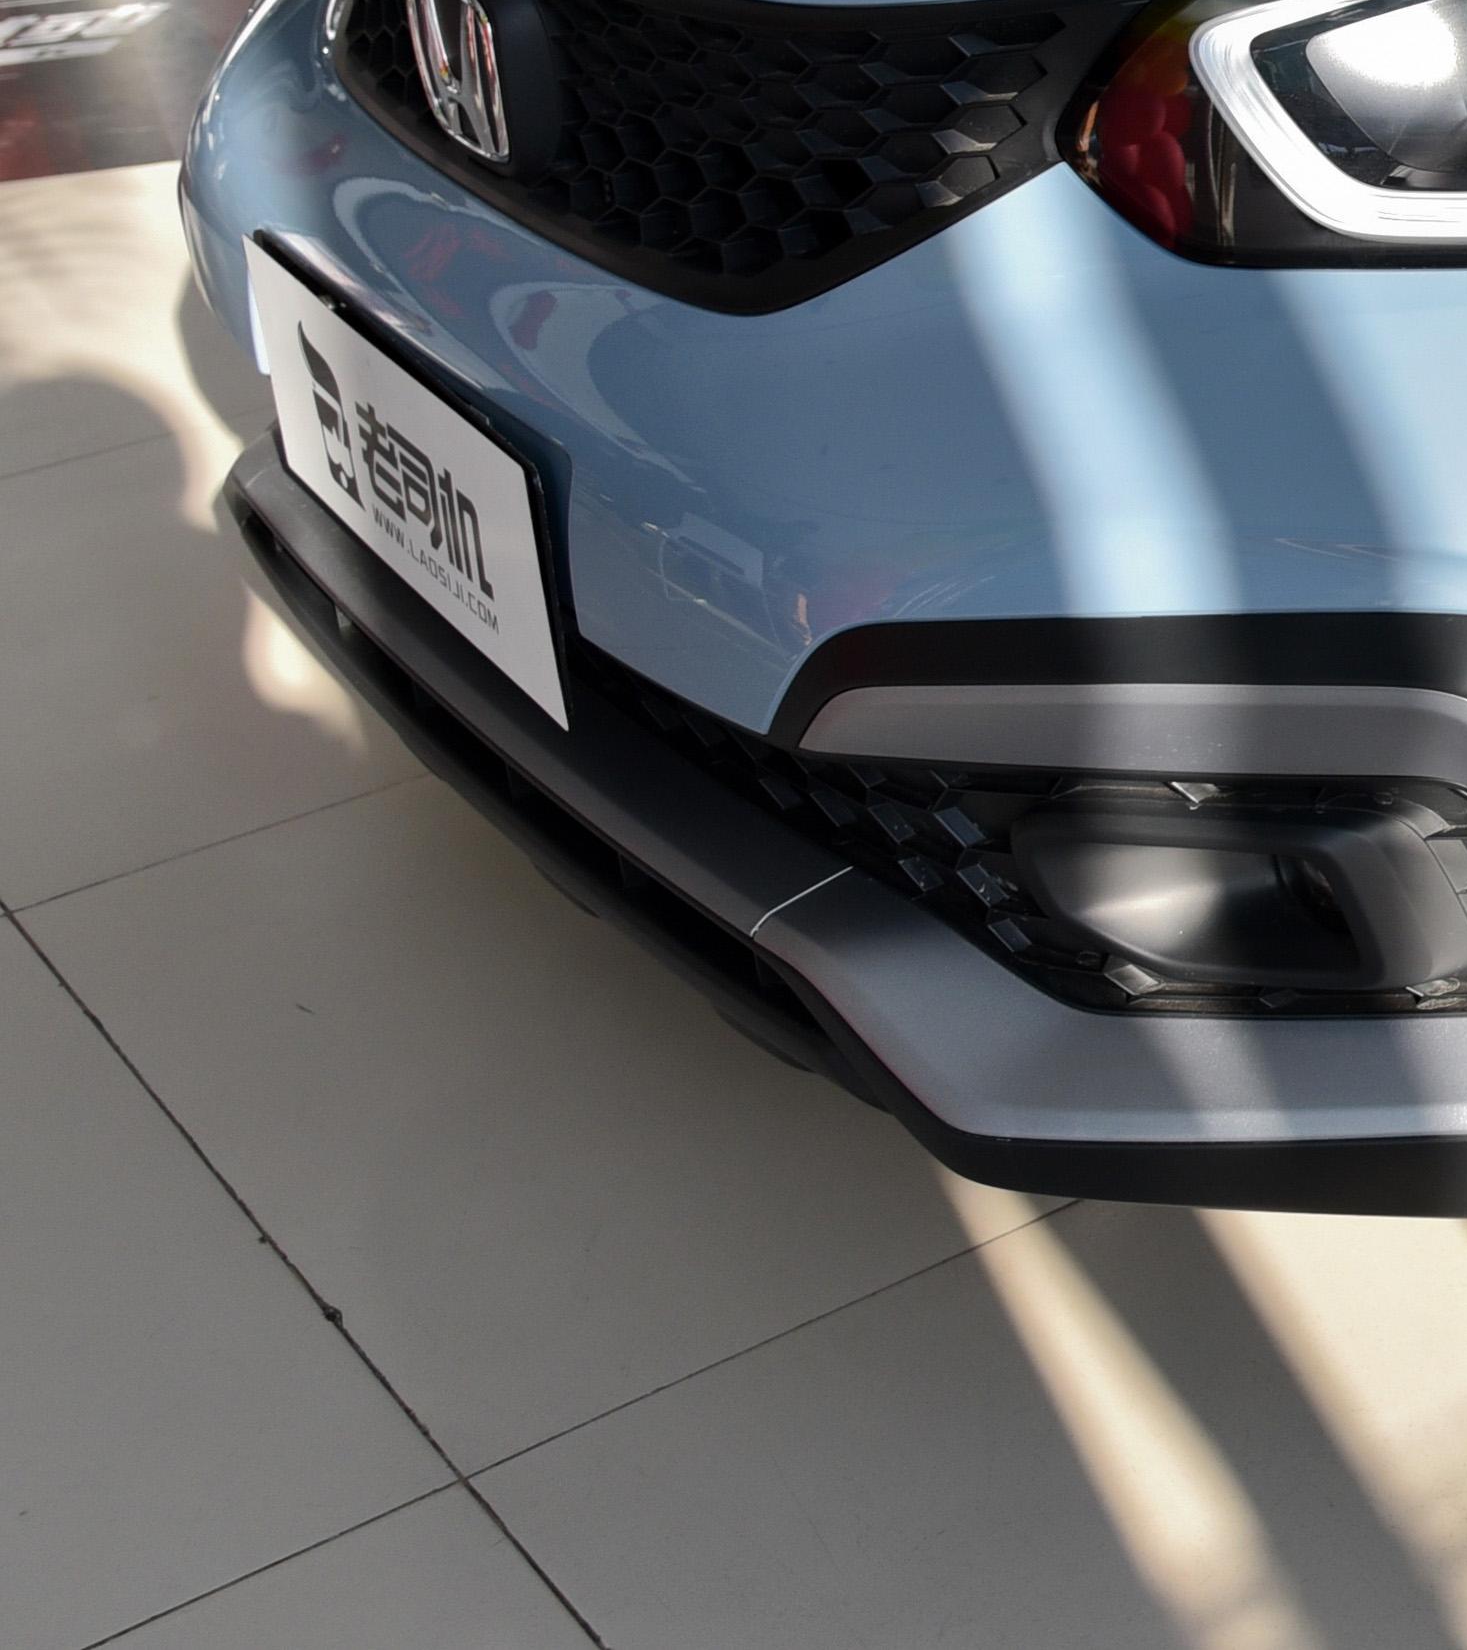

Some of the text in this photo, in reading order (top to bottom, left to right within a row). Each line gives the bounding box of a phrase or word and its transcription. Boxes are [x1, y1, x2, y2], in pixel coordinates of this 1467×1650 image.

[354, 400, 495, 602] 老司机
[371, 506, 500, 636] WWW.LAOSIJI.COM
